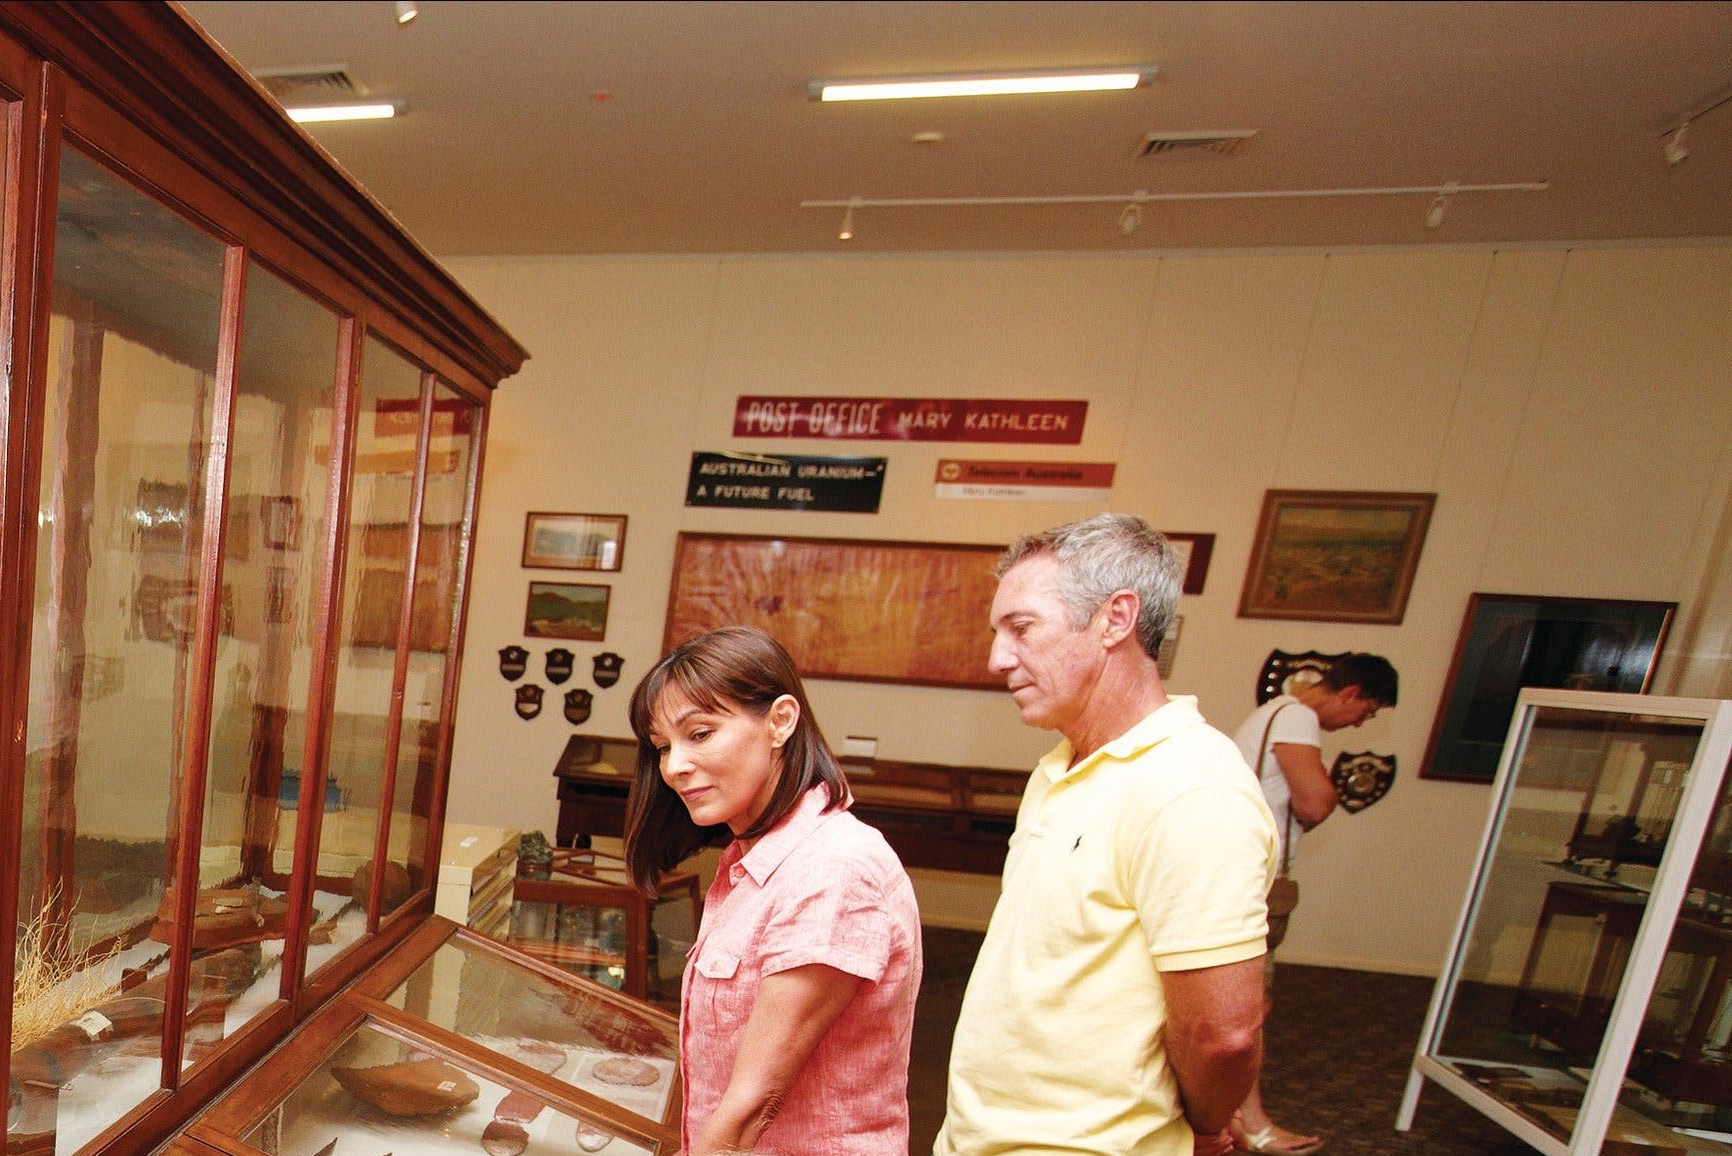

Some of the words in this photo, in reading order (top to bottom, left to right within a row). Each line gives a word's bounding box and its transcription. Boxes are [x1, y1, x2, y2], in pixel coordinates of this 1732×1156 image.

[746, 401, 799, 433] POST
[808, 402, 883, 435] OFFICE
[897, 411, 952, 430] MARY
[964, 412, 1068, 431] KATHLEEN
[699, 462, 791, 478] AUSTRALIAN
[696, 486, 707, 498] A
[714, 485, 771, 500] FUTURE
[777, 486, 815, 501] FUEL
